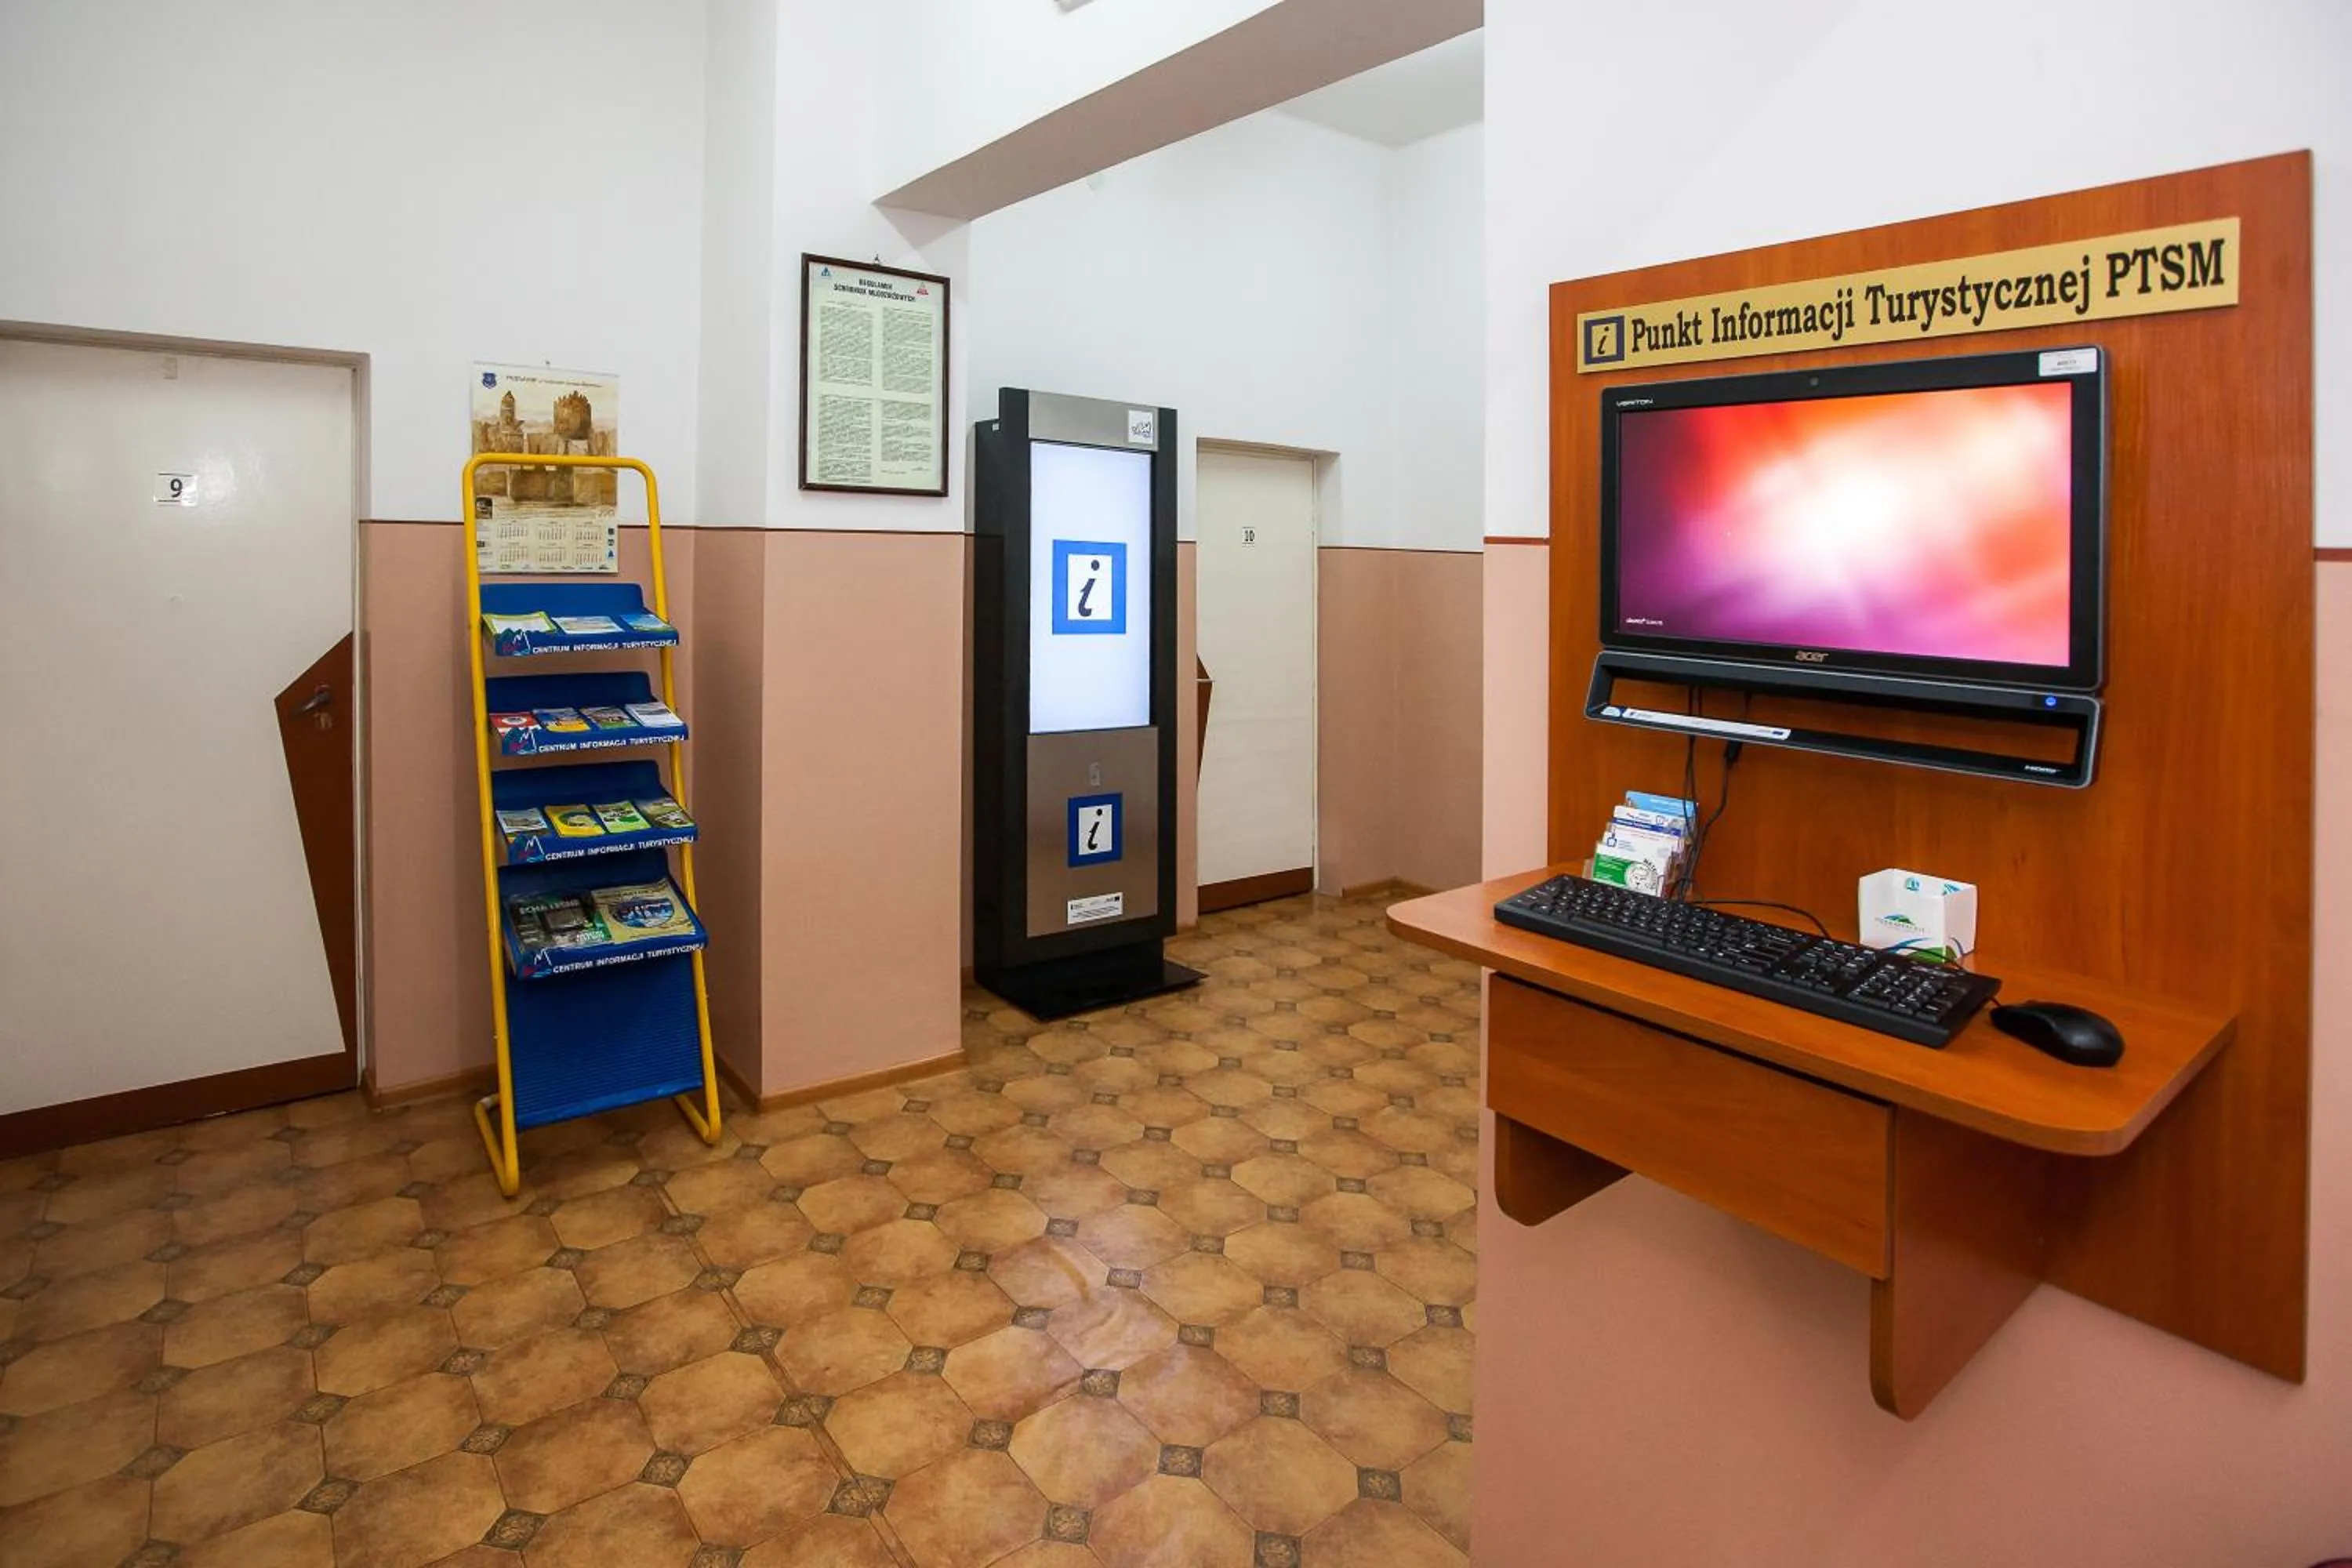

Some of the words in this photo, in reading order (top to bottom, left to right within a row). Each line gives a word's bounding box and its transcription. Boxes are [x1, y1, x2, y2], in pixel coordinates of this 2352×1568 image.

[1631, 310, 1704, 354] Punkt
[1711, 287, 1856, 341] Informacji
[1864, 254, 2091, 332] Turystycznej
[2106, 238, 2225, 298] PTSM
[170, 478, 183, 498] 9
[1244, 529, 1255, 542] 10
[532, 645, 570, 654] CENTRUM
[573, 642, 619, 652] INFORMACJI
[1795, 650, 1830, 662] acer
[539, 743, 577, 753] CENTRUM
[579, 739, 626, 750] INFORMACJI
[545, 849, 585, 861] CENTRUM
[587, 844, 636, 856] INFORMACJI
[553, 960, 593, 974] CENTRUM
[596, 952, 644, 966] INFORMACJI
